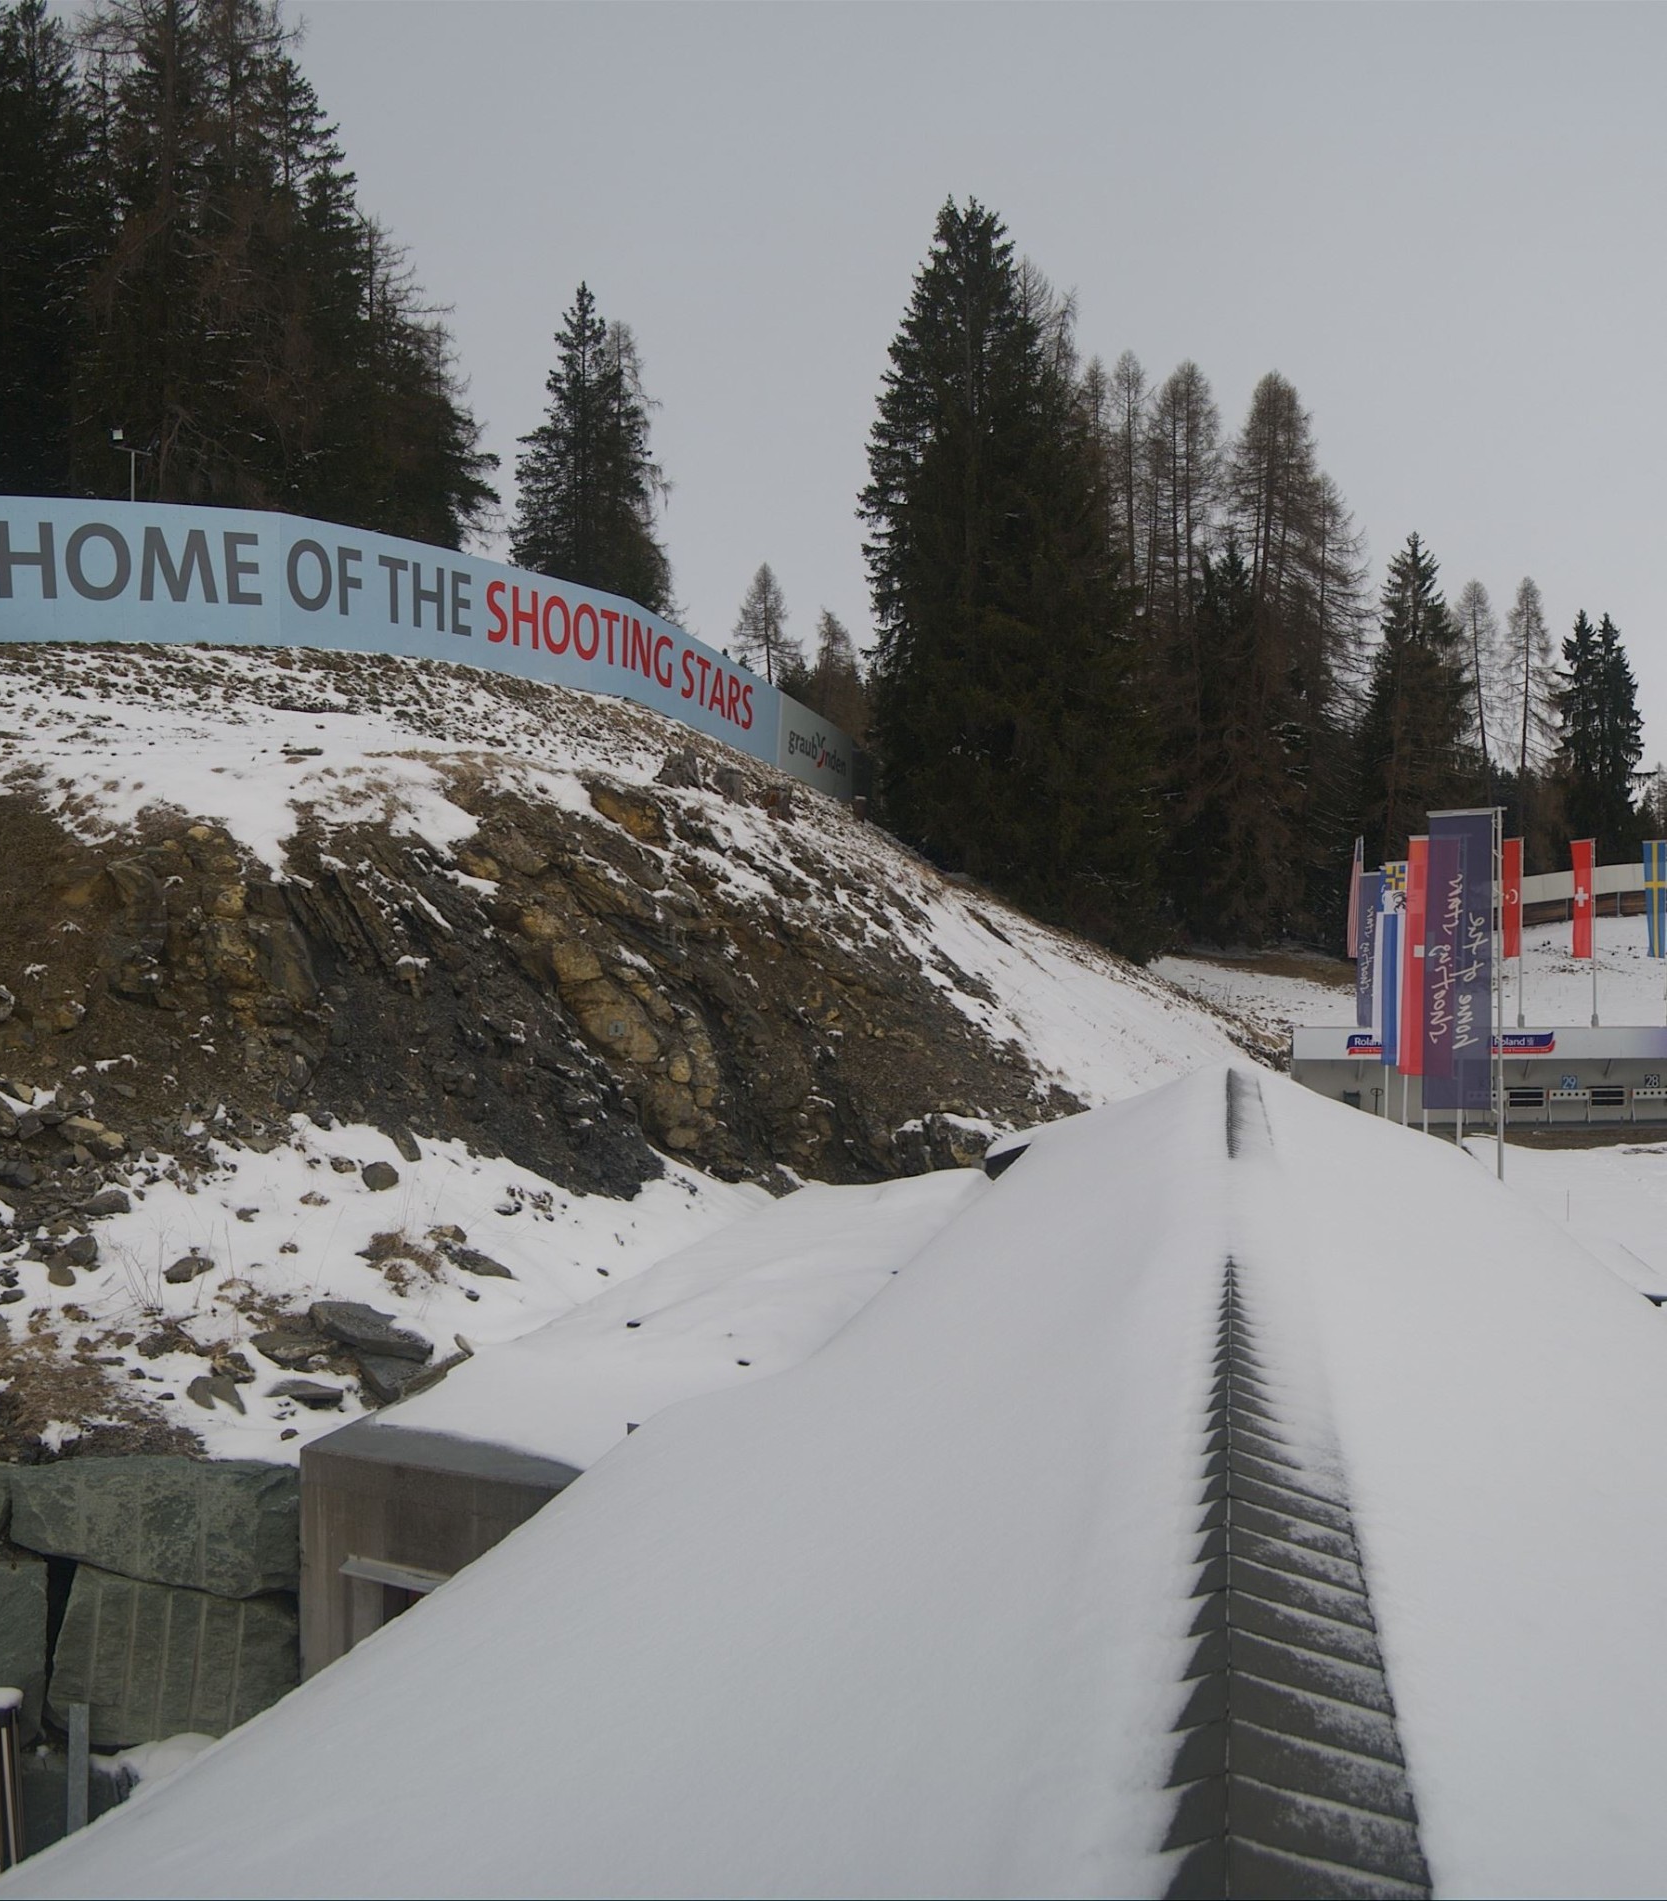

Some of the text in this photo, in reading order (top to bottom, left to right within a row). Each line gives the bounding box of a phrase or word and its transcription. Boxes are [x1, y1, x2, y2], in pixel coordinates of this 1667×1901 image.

[287, 538, 363, 616] OF
[378, 554, 472, 637] THE
[486, 580, 674, 688] SHOOTING
[680, 649, 753, 730] STARS
[1354, 1037, 1382, 1046] Rolan
[1562, 1076, 1577, 1089] 29
[1645, 1074, 1659, 1088] 28
